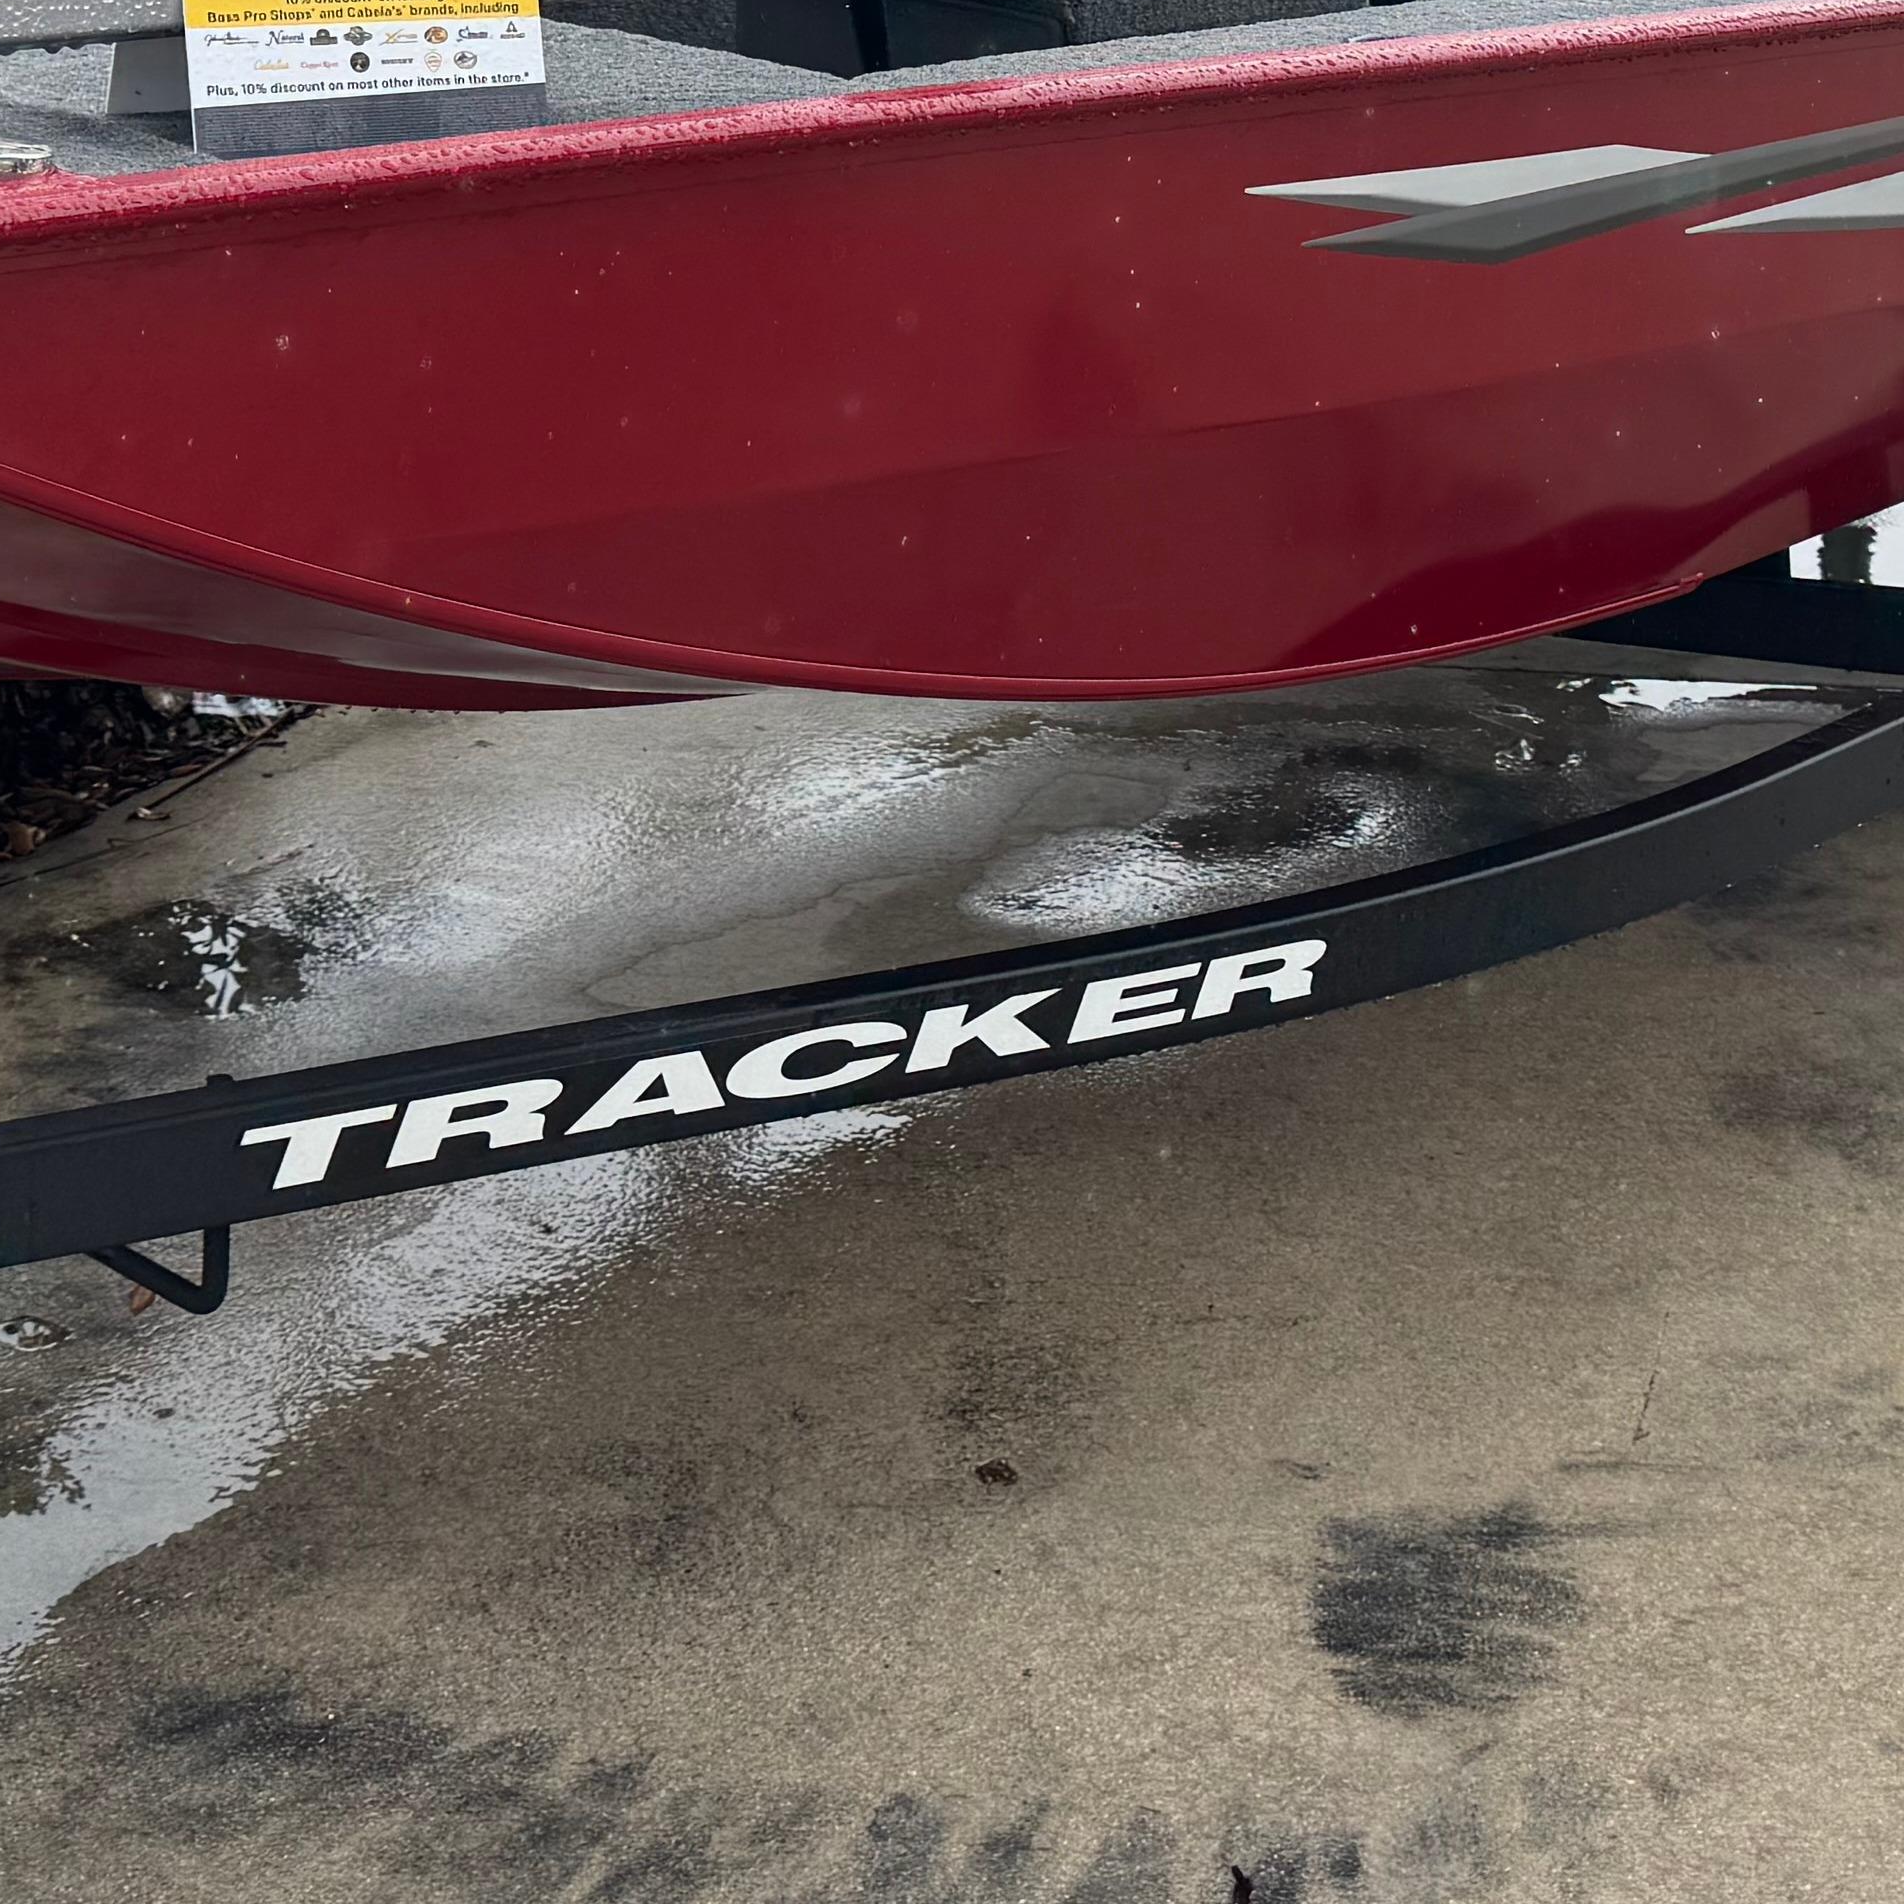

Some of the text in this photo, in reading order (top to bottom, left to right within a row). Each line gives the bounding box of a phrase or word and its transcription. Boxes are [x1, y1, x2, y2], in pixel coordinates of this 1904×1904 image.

[207, 11, 240, 23] Bass
[244, 10, 267, 21] Pro
[319, 7, 343, 19] and
[409, 4, 458, 16] brands,
[461, 2, 519, 15] including
[207, 84, 239, 96] Plus,
[241, 83, 267, 95] 10%
[270, 82, 325, 94] discount
[328, 82, 344, 91] on
[347, 79, 378, 90] most
[382, 76, 413, 89] other
[417, 75, 451, 87] items
[453, 74, 465, 85] in
[468, 73, 488, 85] the
[240, 938, 1327, 1190] TRACKER
